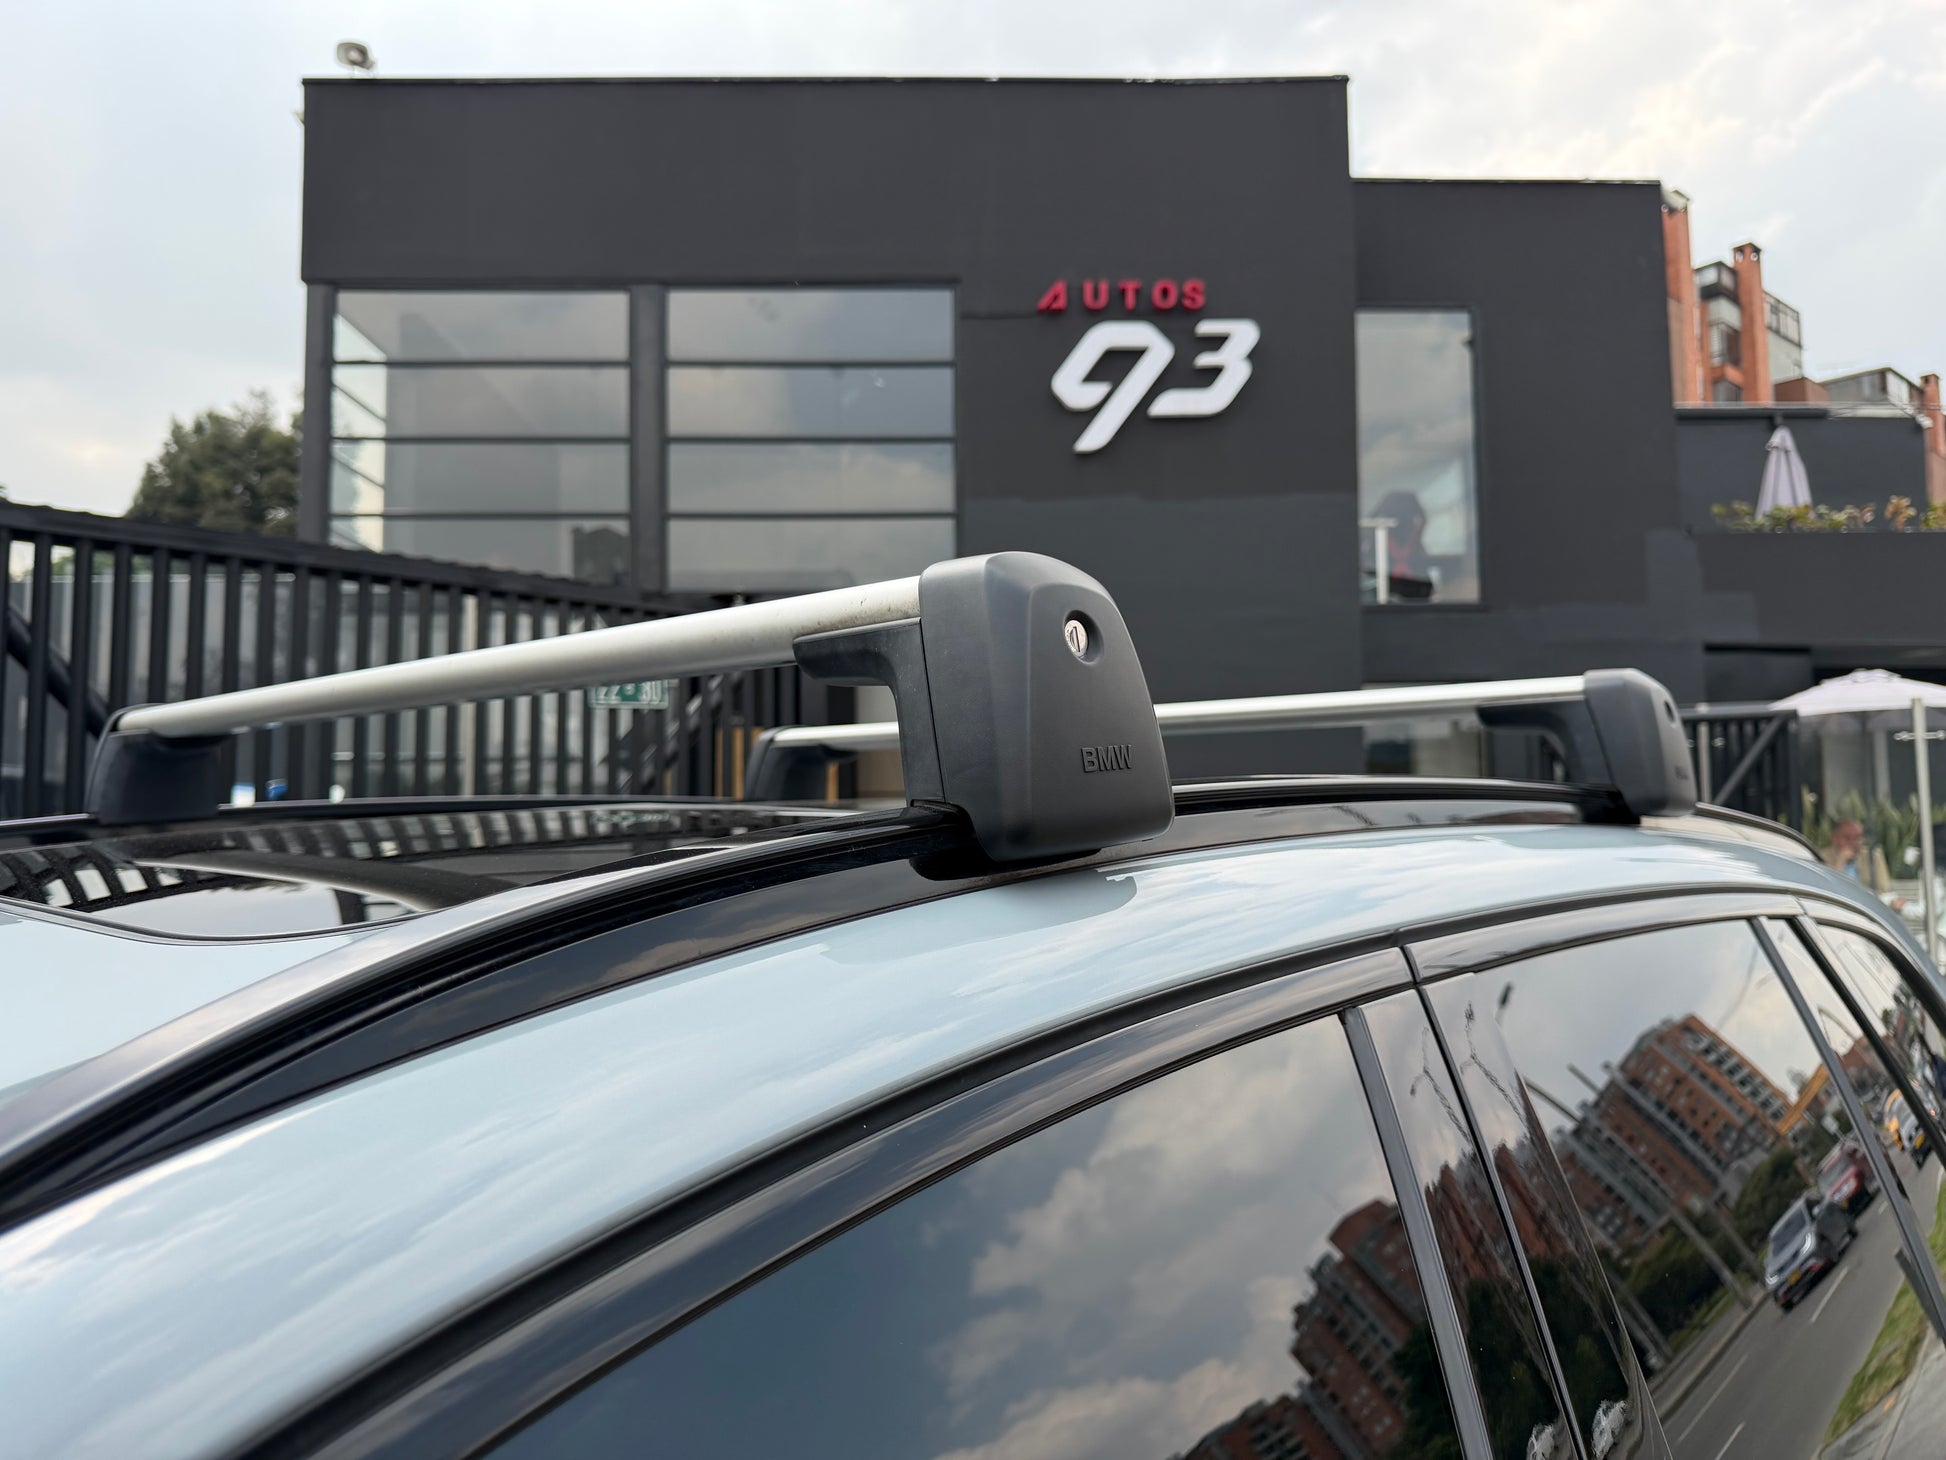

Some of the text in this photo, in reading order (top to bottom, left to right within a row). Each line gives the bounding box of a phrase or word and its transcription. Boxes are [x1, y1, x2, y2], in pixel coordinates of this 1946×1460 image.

[1037, 279, 1207, 313] AUTOS
[1050, 317, 1261, 455] 93
[1080, 744, 1133, 773] BMW
